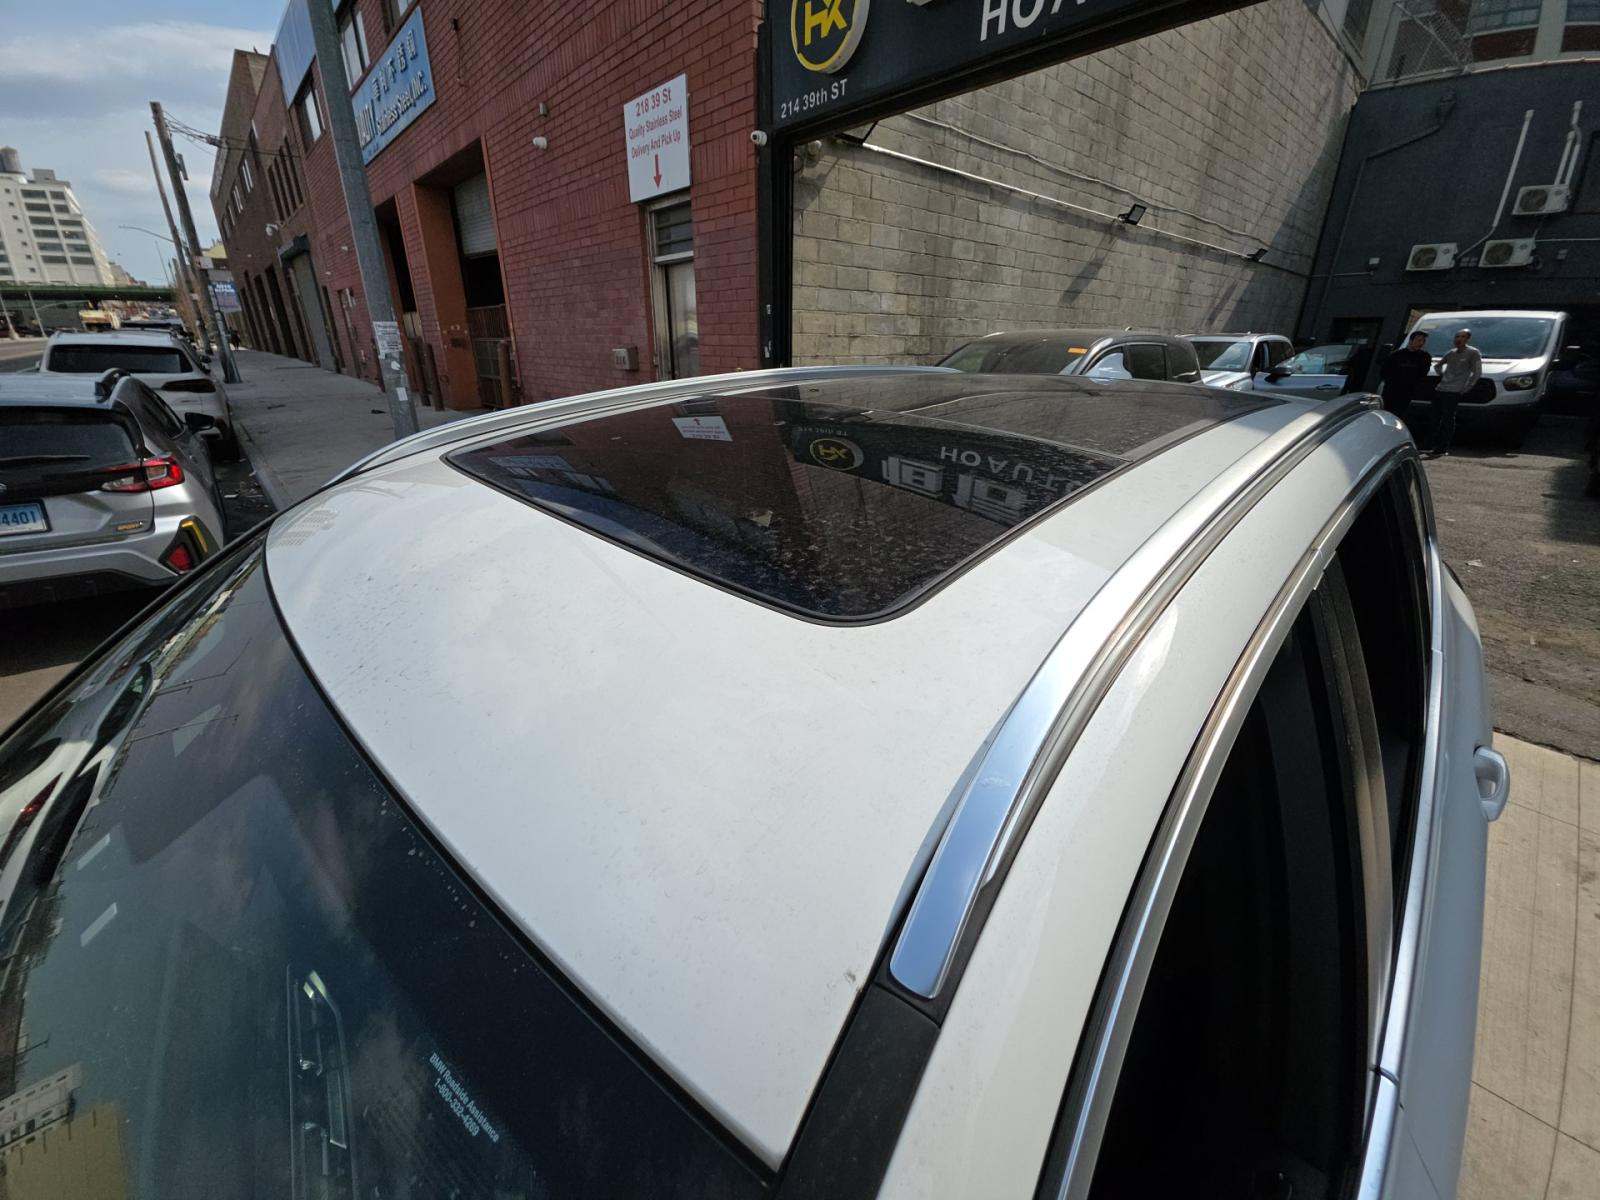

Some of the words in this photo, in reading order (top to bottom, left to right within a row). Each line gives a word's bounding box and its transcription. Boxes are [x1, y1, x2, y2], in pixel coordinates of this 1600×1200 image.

[635, 97, 649, 117] 218
[651, 92, 660, 112] 39
[662, 87, 672, 105] St
[781, 98, 800, 119] 214
[803, 88, 828, 111] 39th
[831, 78, 848, 100] ST
[629, 123, 646, 140] Quality
[645, 114, 668, 133] Stainless
[669, 105, 683, 122] Steel
[631, 142, 650, 160] Delivery
[650, 136, 661, 150] And
[661, 131, 672, 147] Pick
[672, 129, 681, 145] Up
[429, 1052, 447, 1075] BMW
[442, 1069, 470, 1105] Roadside
[466, 1100, 500, 1143] Assistance
